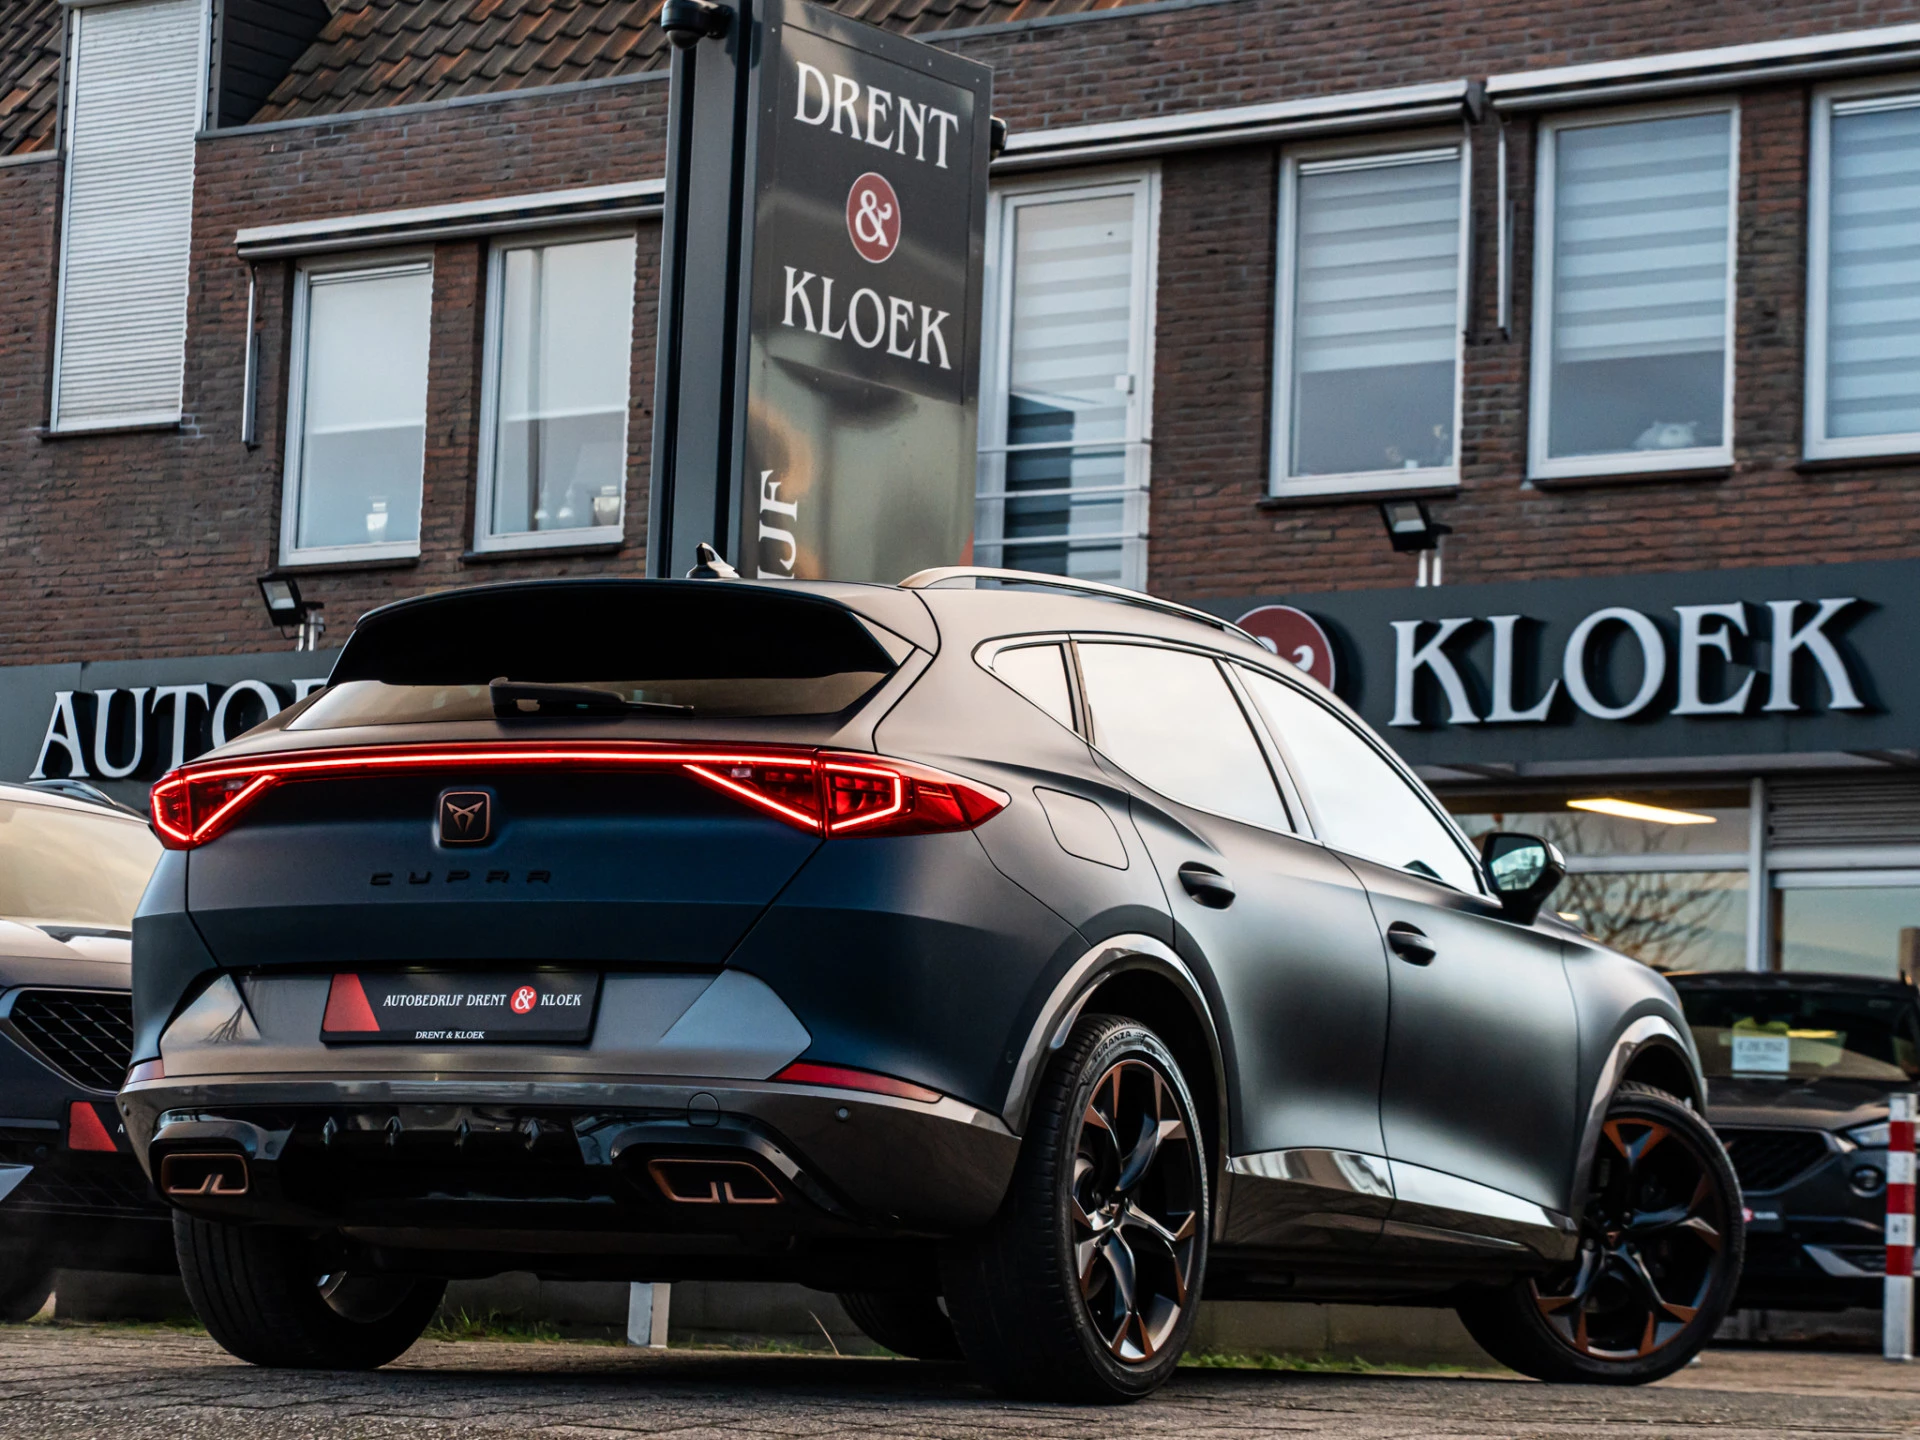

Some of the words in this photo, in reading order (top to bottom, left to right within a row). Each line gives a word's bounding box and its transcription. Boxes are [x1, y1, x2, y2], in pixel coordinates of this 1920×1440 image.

[793, 61, 959, 169] DRENT
[855, 189, 893, 248] &
[781, 266, 951, 370] KLOEK
[1388, 597, 1866, 727] KLOEK
[29, 678, 327, 780] AUTO
[370, 870, 551, 886] CUPRA
[383, 994, 464, 1007] AUTOBEDRIJF
[466, 994, 506, 1007] DRENT
[514, 988, 535, 1010] &
[541, 994, 582, 1006] KLOEK
[415, 1031, 446, 1039] DRENT
[446, 1031, 453, 1039] &
[454, 1031, 485, 1039] KLOEK
[1093, 1030, 1131, 1062] TURANZA
